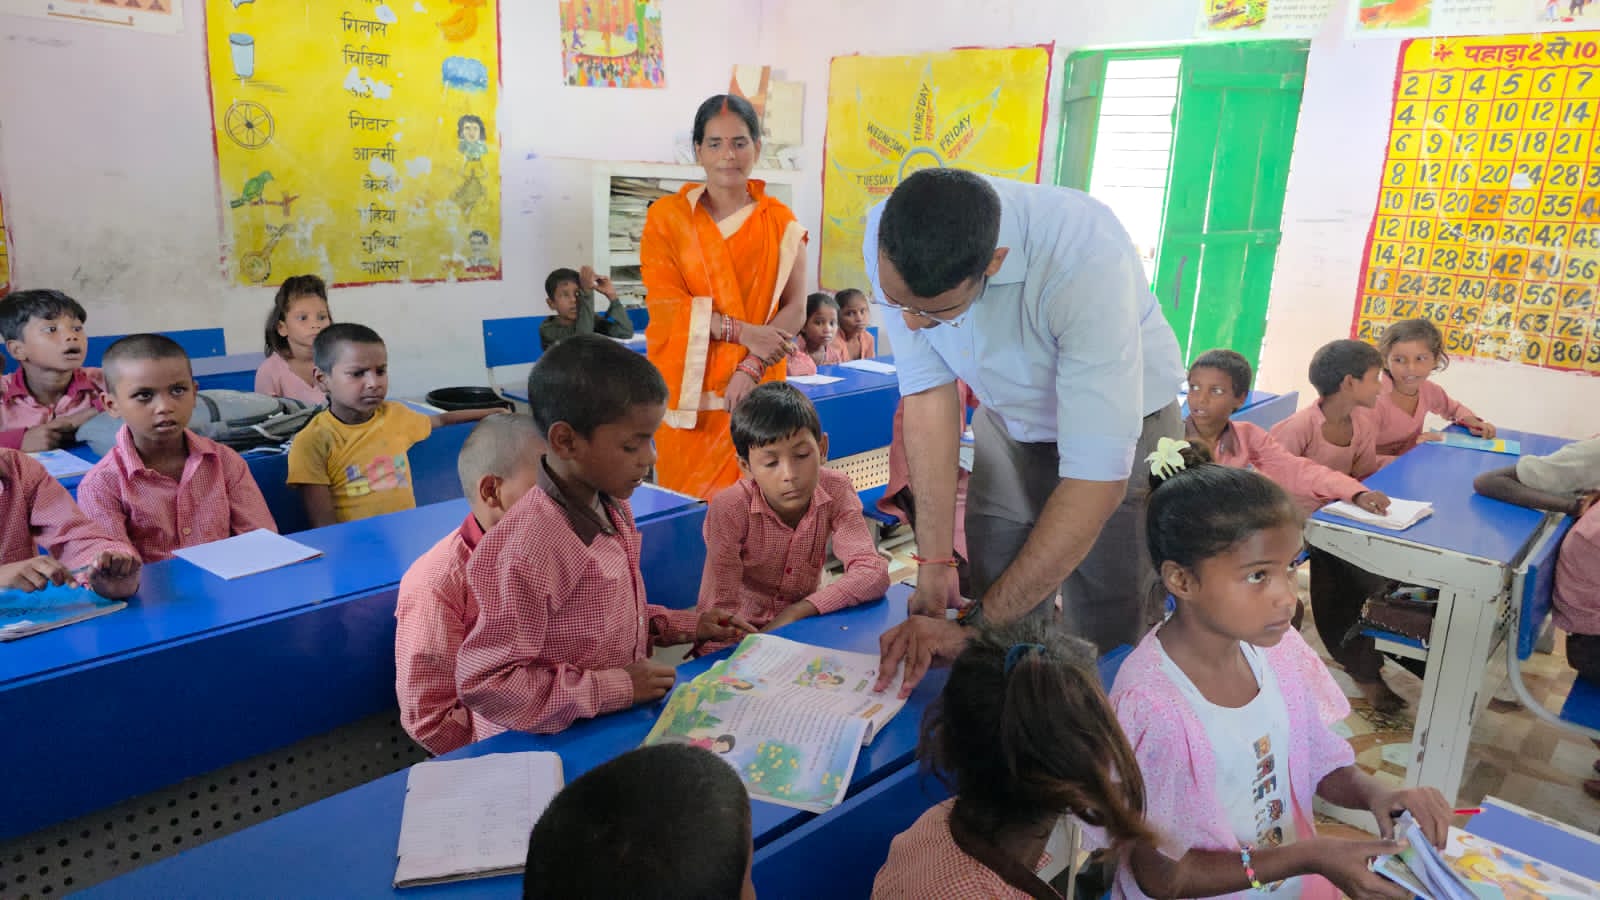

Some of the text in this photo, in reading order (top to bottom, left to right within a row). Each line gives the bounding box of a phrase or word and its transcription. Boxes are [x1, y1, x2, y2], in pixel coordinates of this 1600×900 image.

[1464, 36, 1598, 69] पहाड़ा 2 से 10
[1405, 72, 1592, 95] 2 3 4 5 6 7
[1397, 101, 1590, 125] 4 6 8 10 12 14
[940, 114, 972, 151] FRIDAY
[1395, 134, 1412, 152] 6
[1427, 133, 1443, 154] 9
[1454, 133, 1479, 152] 12
[1489, 132, 1513, 152] 15
[1522, 131, 1547, 153] 18
[1555, 133, 1582, 154] 21
[856, 175, 895, 186] TUESDAY
[1391, 162, 1406, 184] 8
[1420, 163, 1441, 183] 12
[1450, 164, 1472, 183] 16
[1480, 165, 1508, 184] 20
[1550, 163, 1580, 186] 28
[1384, 191, 1600, 218] 10 15 20 25 30 35 4
[1380, 218, 1401, 237] 12
[1410, 220, 1430, 239] 18
[1438, 222, 1465, 241] 24
[1467, 224, 1495, 242] 30
[1503, 224, 1531, 245] 36
[1535, 225, 1567, 247] 42
[1375, 244, 1395, 264] 14
[1403, 246, 1424, 265] 21
[1432, 248, 1458, 270] 28
[1462, 251, 1490, 271] 35
[1493, 254, 1523, 274] 42
[1566, 259, 1598, 279] 56
[1398, 274, 1424, 295] 24
[1426, 276, 1452, 296] 32
[1457, 279, 1485, 299] 40
[1487, 283, 1516, 304] 48
[1523, 285, 1557, 306] 56
[1562, 288, 1593, 311] 64
[1393, 299, 1418, 317] 27
[1421, 302, 1449, 321] 36
[1452, 306, 1481, 325] 45
[1519, 313, 1549, 332] 63
[1557, 315, 1586, 336] 72
[1447, 330, 1473, 351] 50
[1553, 341, 1582, 362] 80
